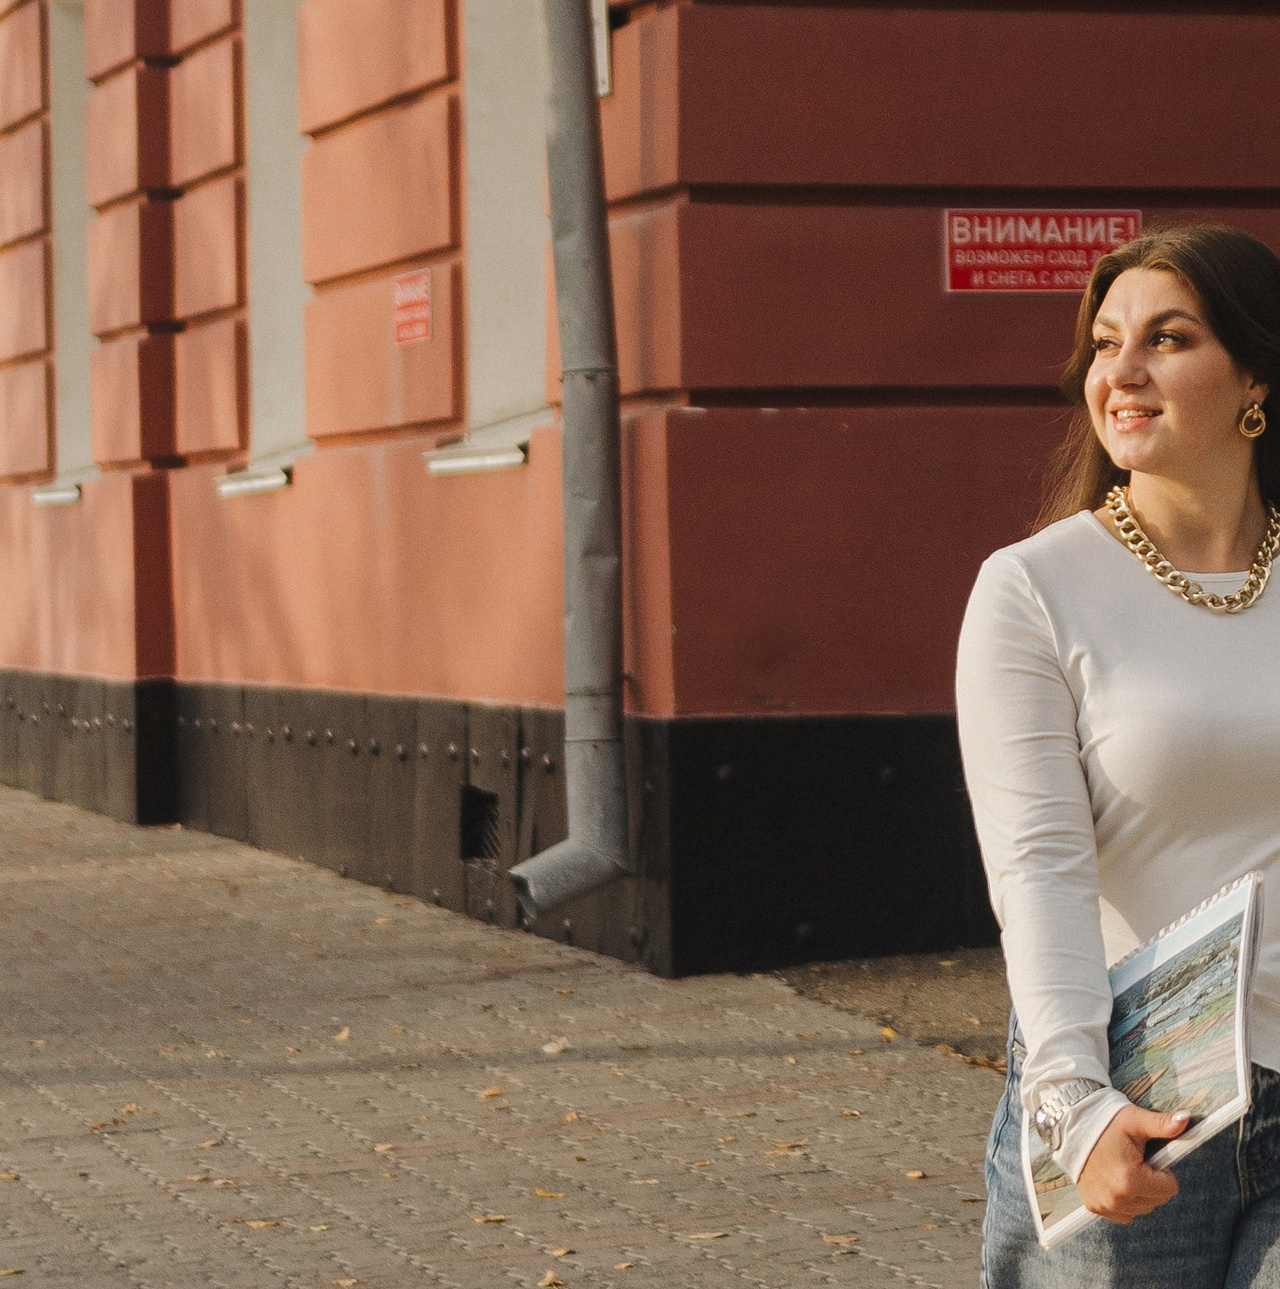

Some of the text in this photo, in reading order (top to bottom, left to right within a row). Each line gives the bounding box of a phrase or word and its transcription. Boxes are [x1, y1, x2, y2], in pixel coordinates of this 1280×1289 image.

[953, 216, 1136, 244] ВНИМАНИЕ!
[955, 249, 1045, 265] ВОЗМОЖЕН
[1049, 249, 1088, 267] СХОД
